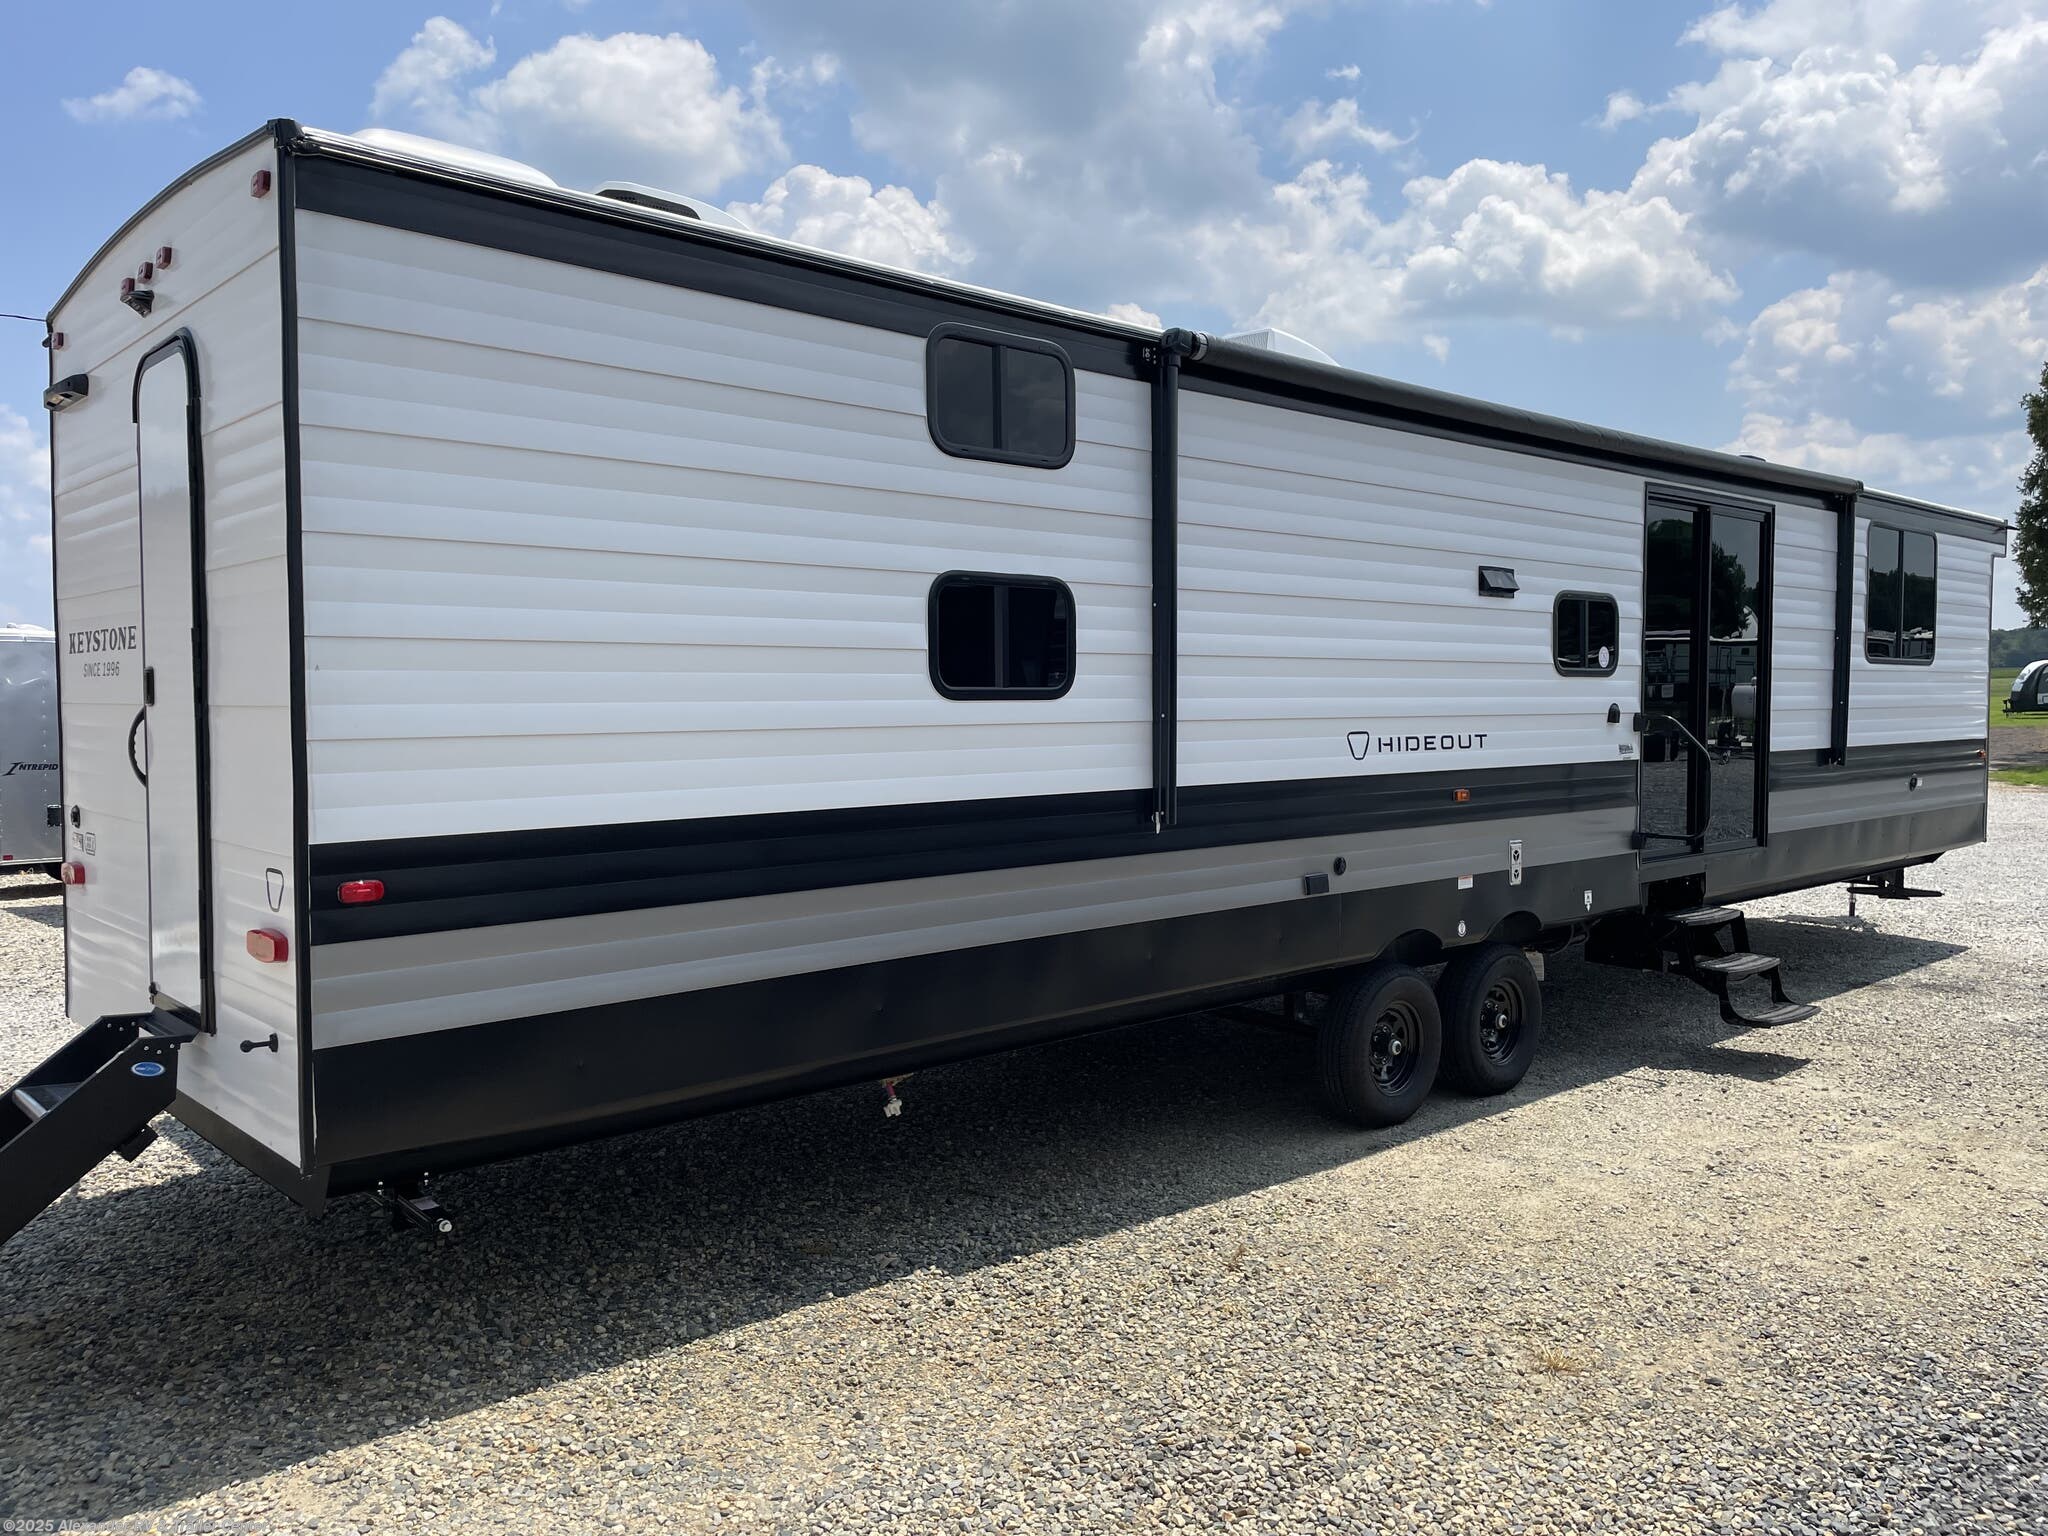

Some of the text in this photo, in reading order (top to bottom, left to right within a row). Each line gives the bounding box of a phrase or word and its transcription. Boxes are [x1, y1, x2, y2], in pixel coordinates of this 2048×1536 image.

[69, 625, 137, 655] KEYSTONE
[83, 661, 120, 678] SINCE 1996
[1378, 734, 1488, 753] HIDEOUT
